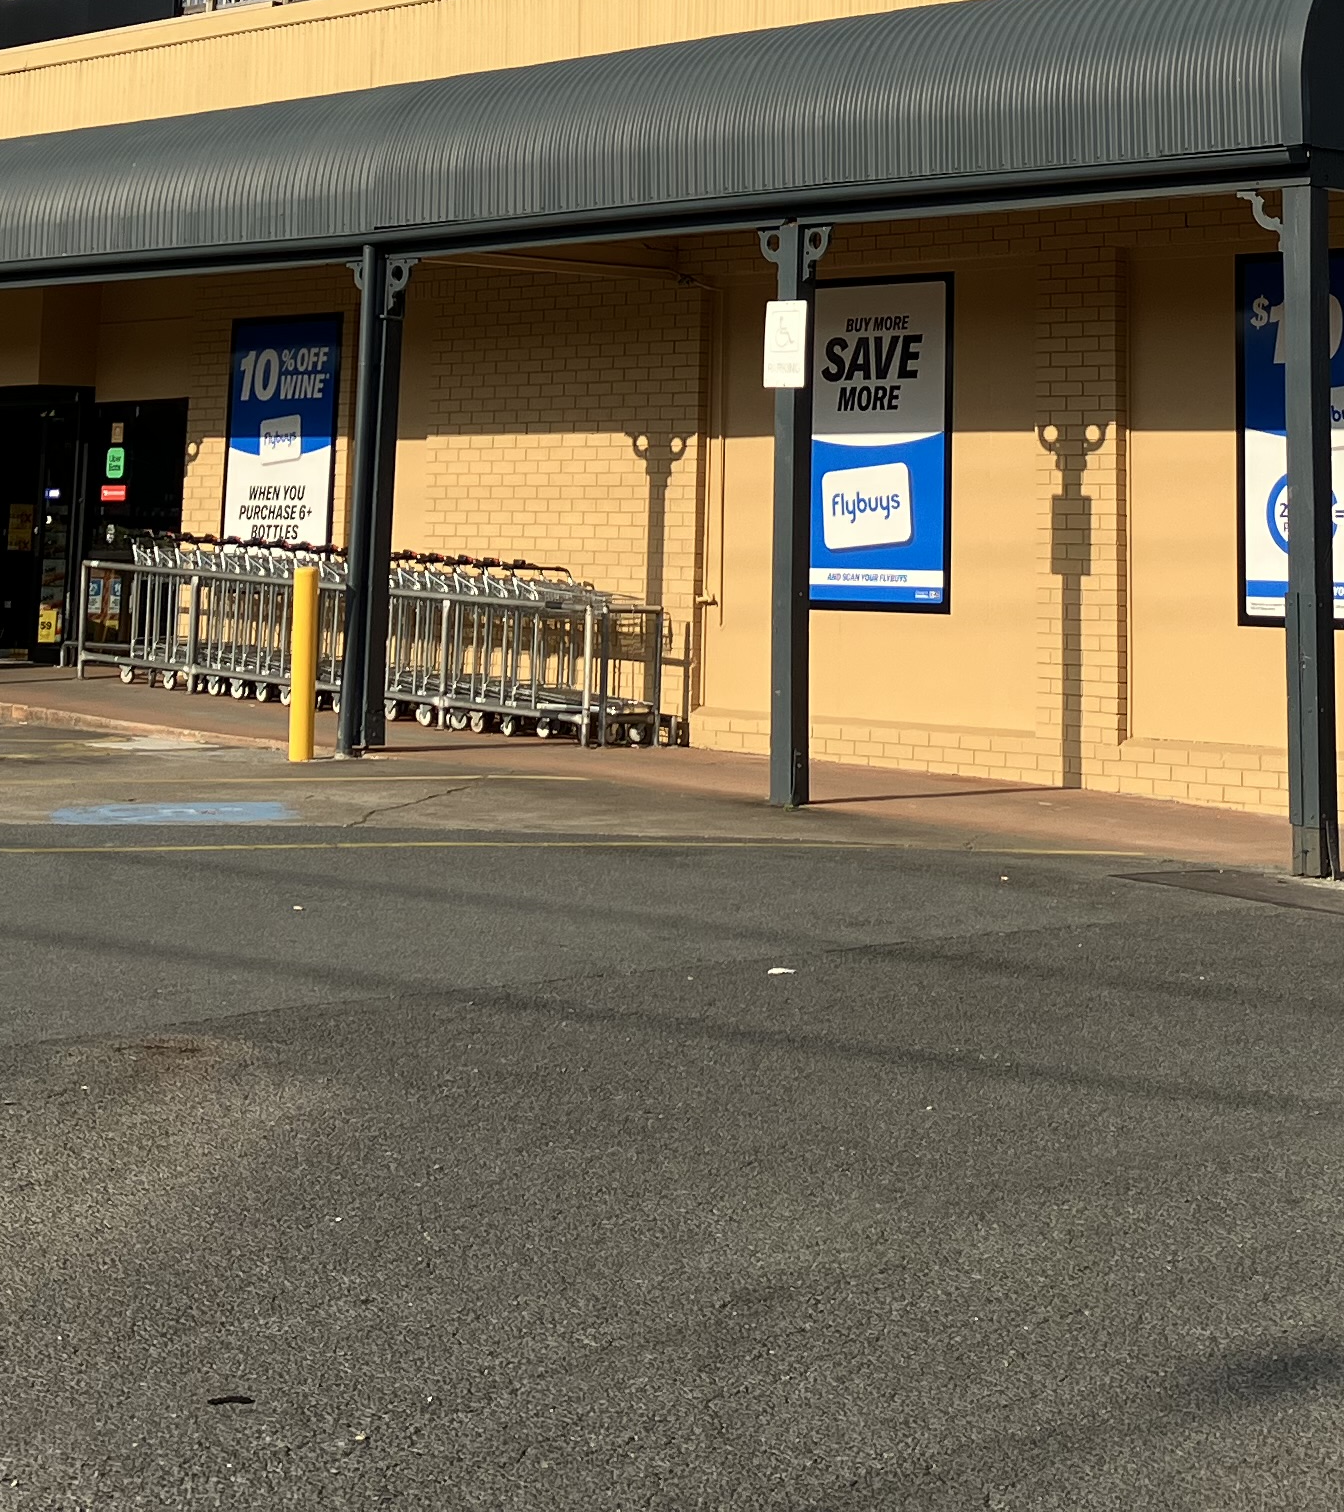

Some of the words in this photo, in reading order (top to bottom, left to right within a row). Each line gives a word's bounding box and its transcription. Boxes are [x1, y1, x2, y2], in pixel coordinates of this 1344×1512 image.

[845, 317, 872, 333] BUY
[873, 315, 909, 332] MORE
[821, 333, 923, 383] SAVE
[240, 348, 279, 402] 10
[837, 385, 901, 412] MORE
[248, 485, 281, 501] WHEN
[282, 484, 306, 501] YOU
[238, 504, 297, 521] PURCHASE
[298, 504, 313, 520] 6+
[831, 491, 901, 524] flybuys
[250, 523, 299, 540] BOTTLES
[827, 572, 841, 581] AND
[842, 573, 860, 581] SCAN
[861, 573, 878, 582] YOUR
